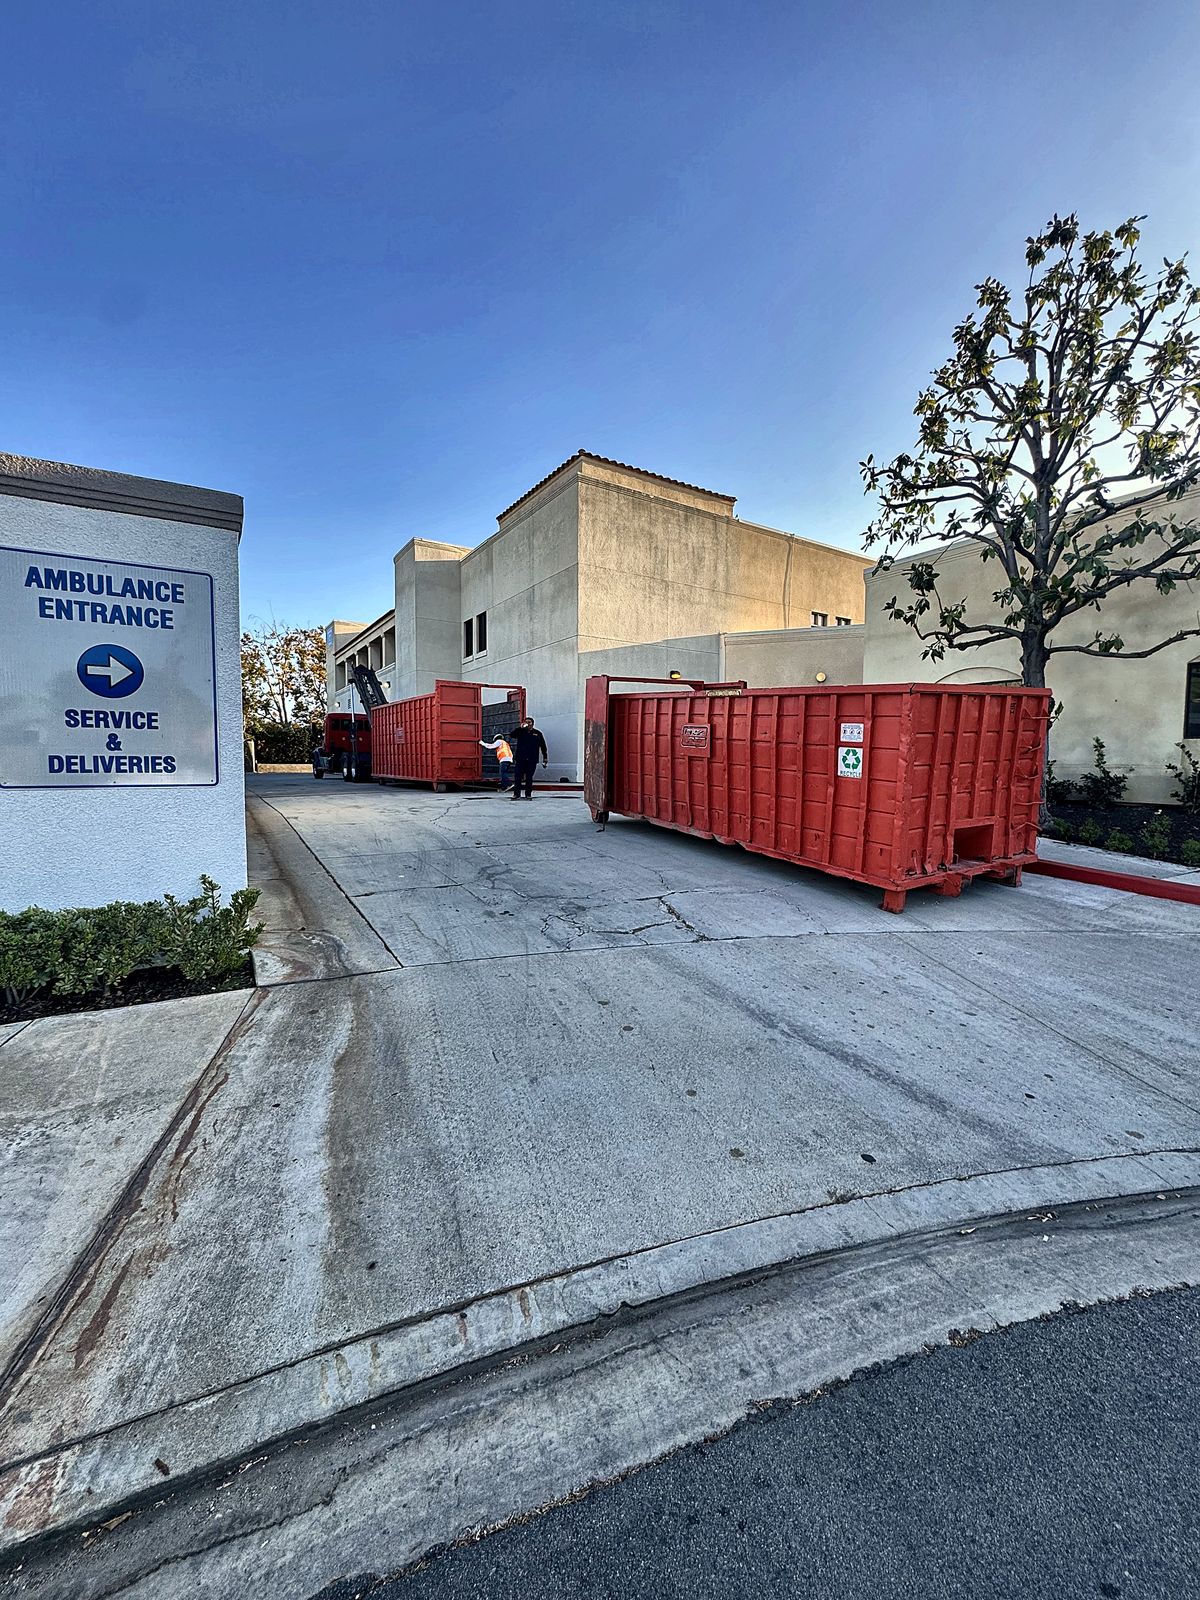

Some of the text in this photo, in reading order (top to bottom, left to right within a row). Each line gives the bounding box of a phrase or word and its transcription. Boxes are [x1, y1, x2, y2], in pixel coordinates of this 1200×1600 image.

[24, 566, 184, 604] AMBULANCE
[38, 597, 174, 629] ENTRANCE
[65, 709, 159, 729] SERVICE
[106, 733, 122, 751] &
[49, 755, 176, 773] DELIVERIES
[840, 770, 861, 778] RECYCLE
